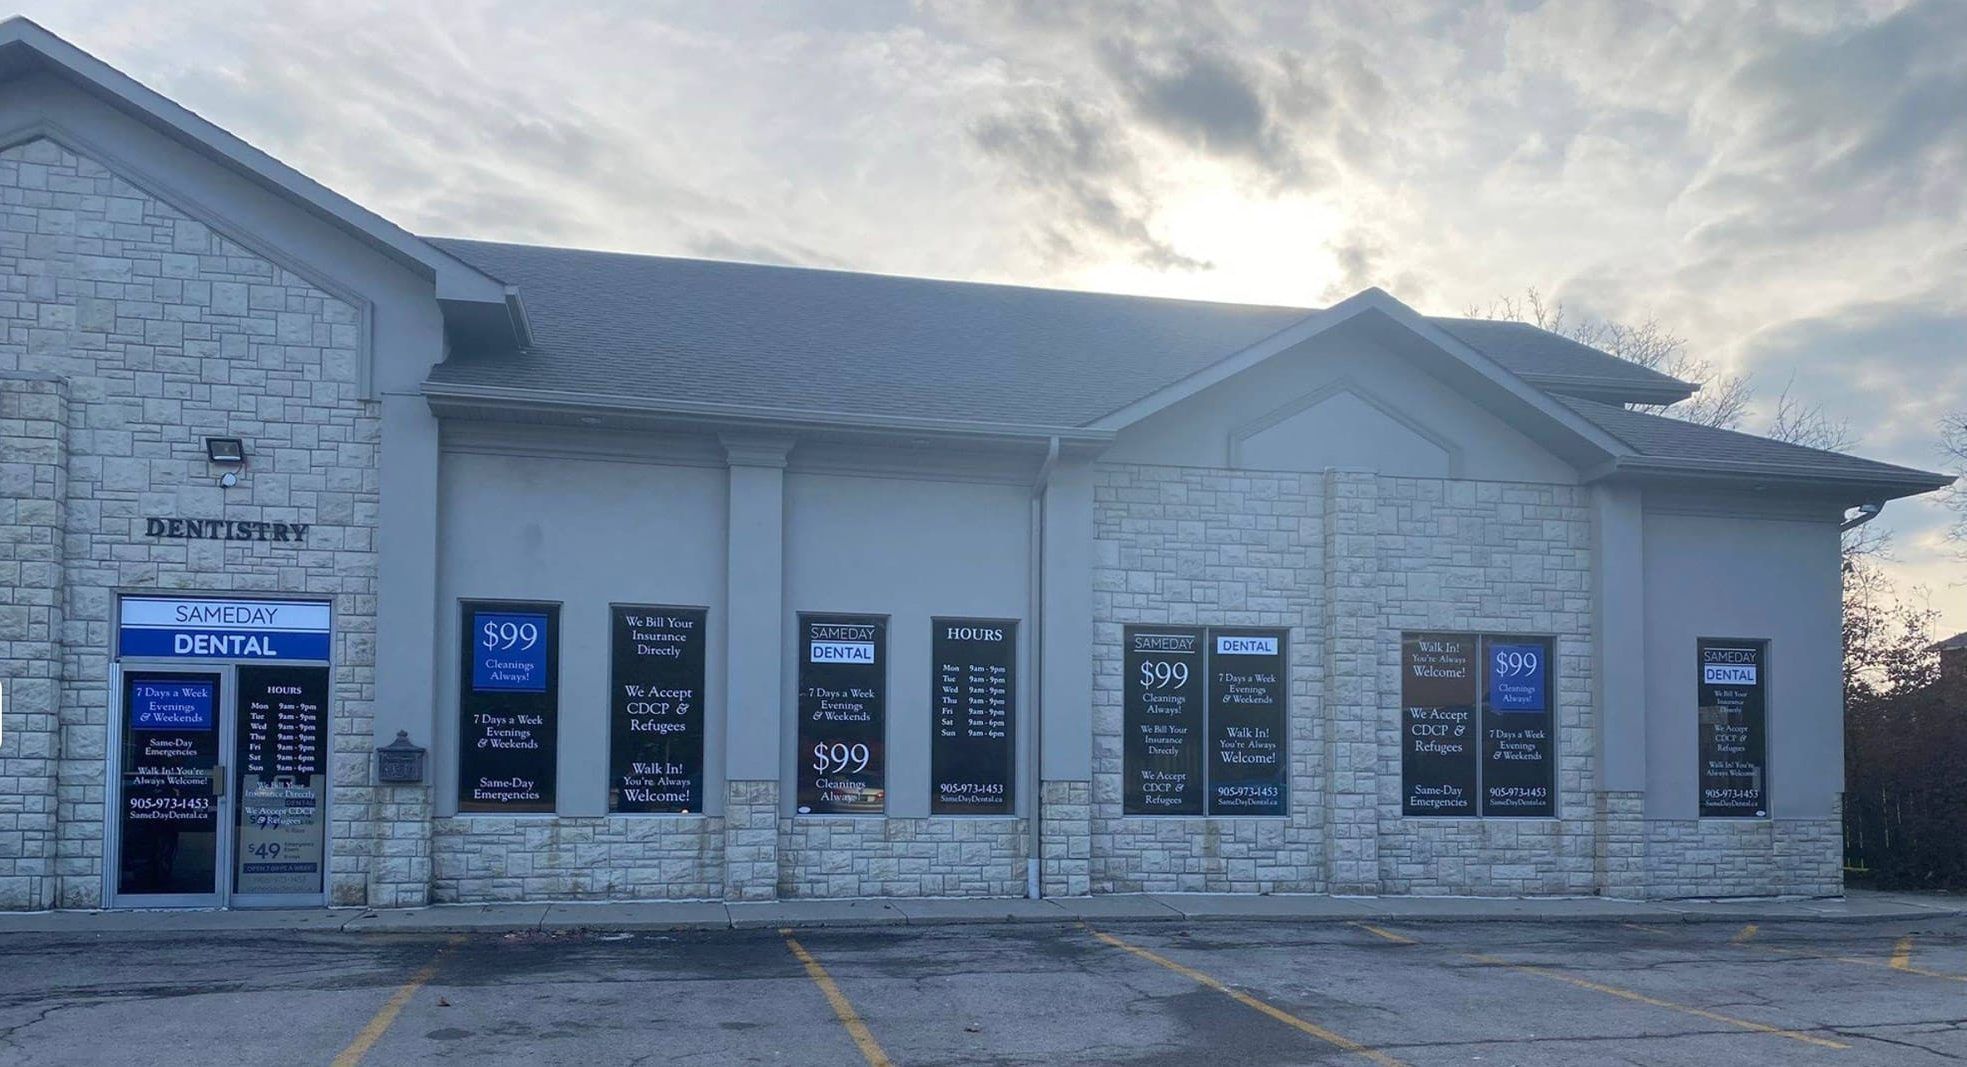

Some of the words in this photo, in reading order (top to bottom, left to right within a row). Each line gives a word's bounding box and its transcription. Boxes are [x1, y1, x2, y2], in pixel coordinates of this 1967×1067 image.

[145, 518, 309, 542] DENTISTRY
[175, 605, 278, 624] SAMEDAY
[626, 616, 643, 626] We
[646, 617, 664, 627] Bill
[668, 618, 693, 628] Your
[483, 620, 537, 651] $99
[632, 631, 687, 641] Insurance
[811, 627, 875, 640] SAMEDAY
[948, 628, 1003, 641] HOURS
[174, 634, 277, 656] DENTAL
[1134, 638, 1194, 649] SAMEDAY
[1223, 640, 1271, 652] DENTAL
[1419, 642, 1442, 652] Walk
[1446, 643, 1459, 653] In!
[637, 644, 681, 658] Directly
[813, 647, 871, 659] DENTAL
[1440, 656, 1466, 665] Always
[1704, 651, 1756, 663] SAMEDAY
[485, 659, 534, 674] Cleanings
[1496, 651, 1537, 677] $99
[1140, 660, 1188, 689] $99
[1413, 666, 1466, 677] Welcome!
[1706, 669, 1754, 681] DENTAL
[490, 672, 530, 684] Always!
[1219, 673, 1223, 681] 7
[1226, 674, 1246, 684] Days
[1255, 674, 1276, 682] Week
[137, 688, 142, 696] 7
[145, 688, 170, 699] Days
[182, 688, 208, 698] Week
[267, 686, 302, 694] HOURS
[625, 685, 644, 697] We
[648, 686, 692, 701] Accept
[809, 688, 814, 697] 7
[817, 688, 839, 700] Days
[850, 689, 875, 698] Week
[1230, 685, 1266, 696] Evenings
[1499, 684, 1535, 695] Cleanings
[989, 698, 1005, 706] 9pm
[1143, 693, 1186, 705] Cleanings
[1223, 695, 1231, 703] &
[1233, 695, 1272, 703] Weekends
[150, 702, 195, 712] Evenings
[627, 703, 670, 715] CDCP
[676, 703, 689, 715] &
[821, 700, 864, 713] Evenings
[1147, 706, 1182, 717] Always!
[140, 713, 150, 722] &
[153, 713, 203, 722] Weekends
[812, 712, 822, 720] &
[825, 712, 870, 721] Weekends
[989, 709, 1005, 717] 9pm
[1410, 708, 1427, 719] We
[1429, 708, 1468, 722] Accept
[474, 714, 479, 724] 7
[482, 714, 506, 727] Days
[517, 715, 543, 724] Week
[631, 720, 686, 734] Refugees
[1141, 725, 1152, 733] We
[1169, 726, 1187, 734] Your
[1227, 727, 1251, 738] Walk
[1255, 728, 1269, 738] In!
[1412, 725, 1449, 736] CDCP
[1454, 726, 1465, 736] &
[486, 727, 531, 740] Evenings
[989, 730, 1004, 738] 6pm
[1145, 735, 1183, 743] Insurance
[1489, 730, 1494, 738] 7
[1496, 730, 1516, 741] Days
[1524, 730, 1545, 738] Week
[150, 738, 193, 748] Same-Day
[477, 739, 488, 748] &
[490, 739, 538, 749] Weekends
[1220, 740, 1245, 748] You're
[1249, 741, 1276, 750] Always
[1415, 740, 1463, 755] Refugees
[1500, 741, 1535, 752] Evenings
[145, 748, 197, 756] Emergencies
[1149, 746, 1179, 757] Directly
[1504, 752, 1542, 760] Weekends
[813, 742, 869, 775] $99
[1221, 752, 1276, 763] Welcome!
[138, 767, 158, 775] Walk
[632, 763, 662, 774] Walk
[666, 763, 683, 774] In!
[134, 777, 165, 786] Always
[624, 776, 654, 786] You're
[657, 777, 691, 788] Always
[1142, 771, 1155, 780] We
[1156, 771, 1187, 782] Accept
[480, 777, 534, 790] Same-Day
[816, 779, 866, 793] Cleanings
[941, 784, 1003, 793] 905-973-1453
[1143, 783, 1172, 792] CDCP
[1175, 783, 1184, 792] &
[474, 789, 540, 801] Emergencies
[624, 790, 690, 802] Welcome!
[1218, 787, 1278, 797] 905-973-1453
[1415, 785, 1463, 796] Same-Day
[1490, 788, 1547, 796] 905-973-1453
[1705, 789, 1759, 798] 905-973-1453
[130, 798, 208, 808] 905-973-1453
[820, 792, 861, 804] Always!
[941, 795, 1003, 804] SameDayDental.ca
[1145, 795, 1182, 806] Refugees
[1410, 796, 1468, 808] Emergencies
[130, 811, 208, 820] SameDayDental.ca
[248, 842, 280, 859] $49
